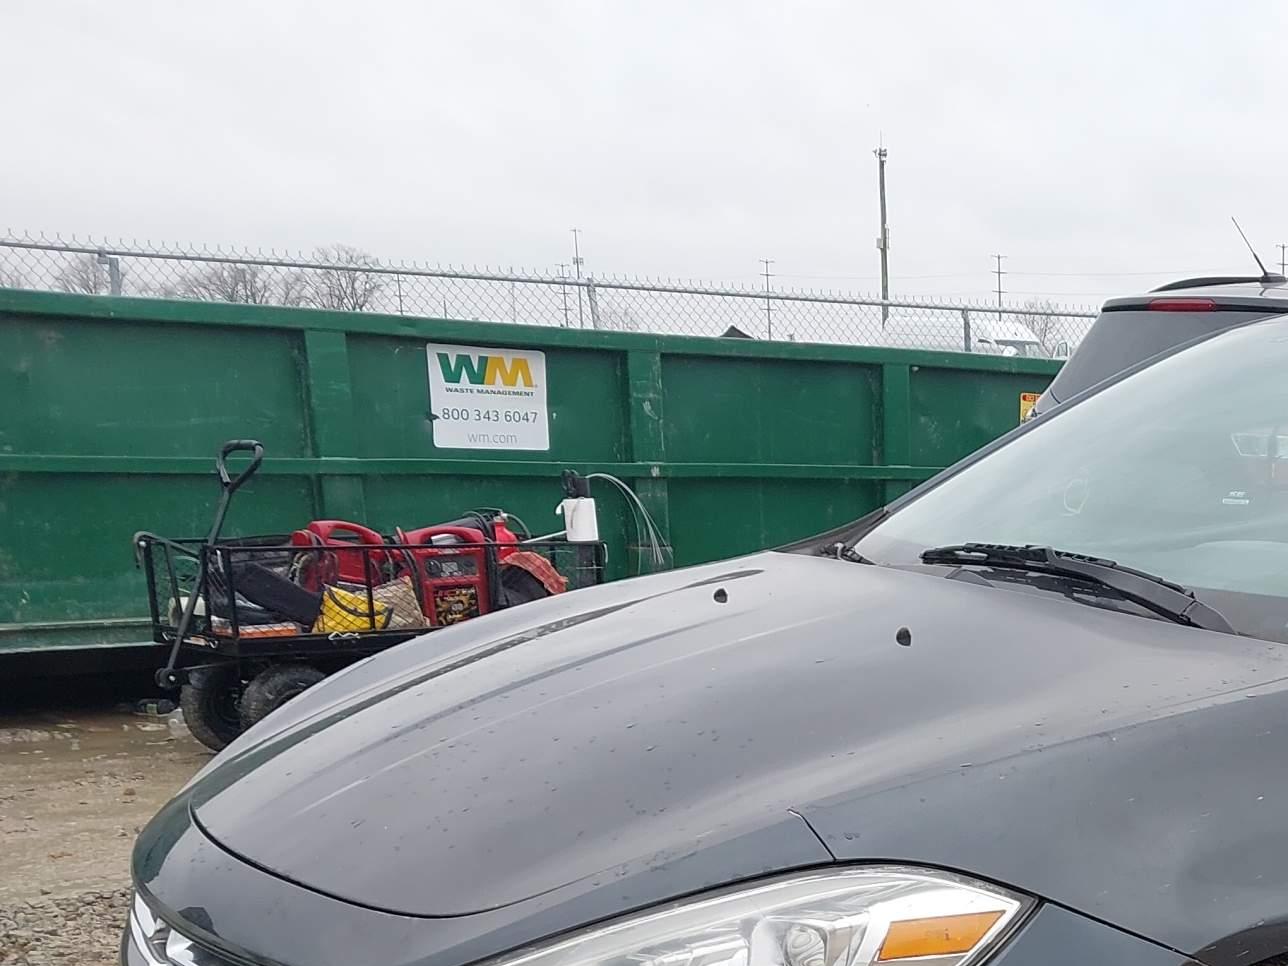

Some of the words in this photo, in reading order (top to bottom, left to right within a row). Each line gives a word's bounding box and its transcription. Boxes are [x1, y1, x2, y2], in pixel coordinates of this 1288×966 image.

[436, 353, 534, 388] WM
[476, 389, 534, 397] MANAGEMENT
[442, 408, 470, 421] 800
[474, 409, 500, 423] 343
[504, 411, 538, 424] 6047
[467, 433, 518, 445] wm.com
